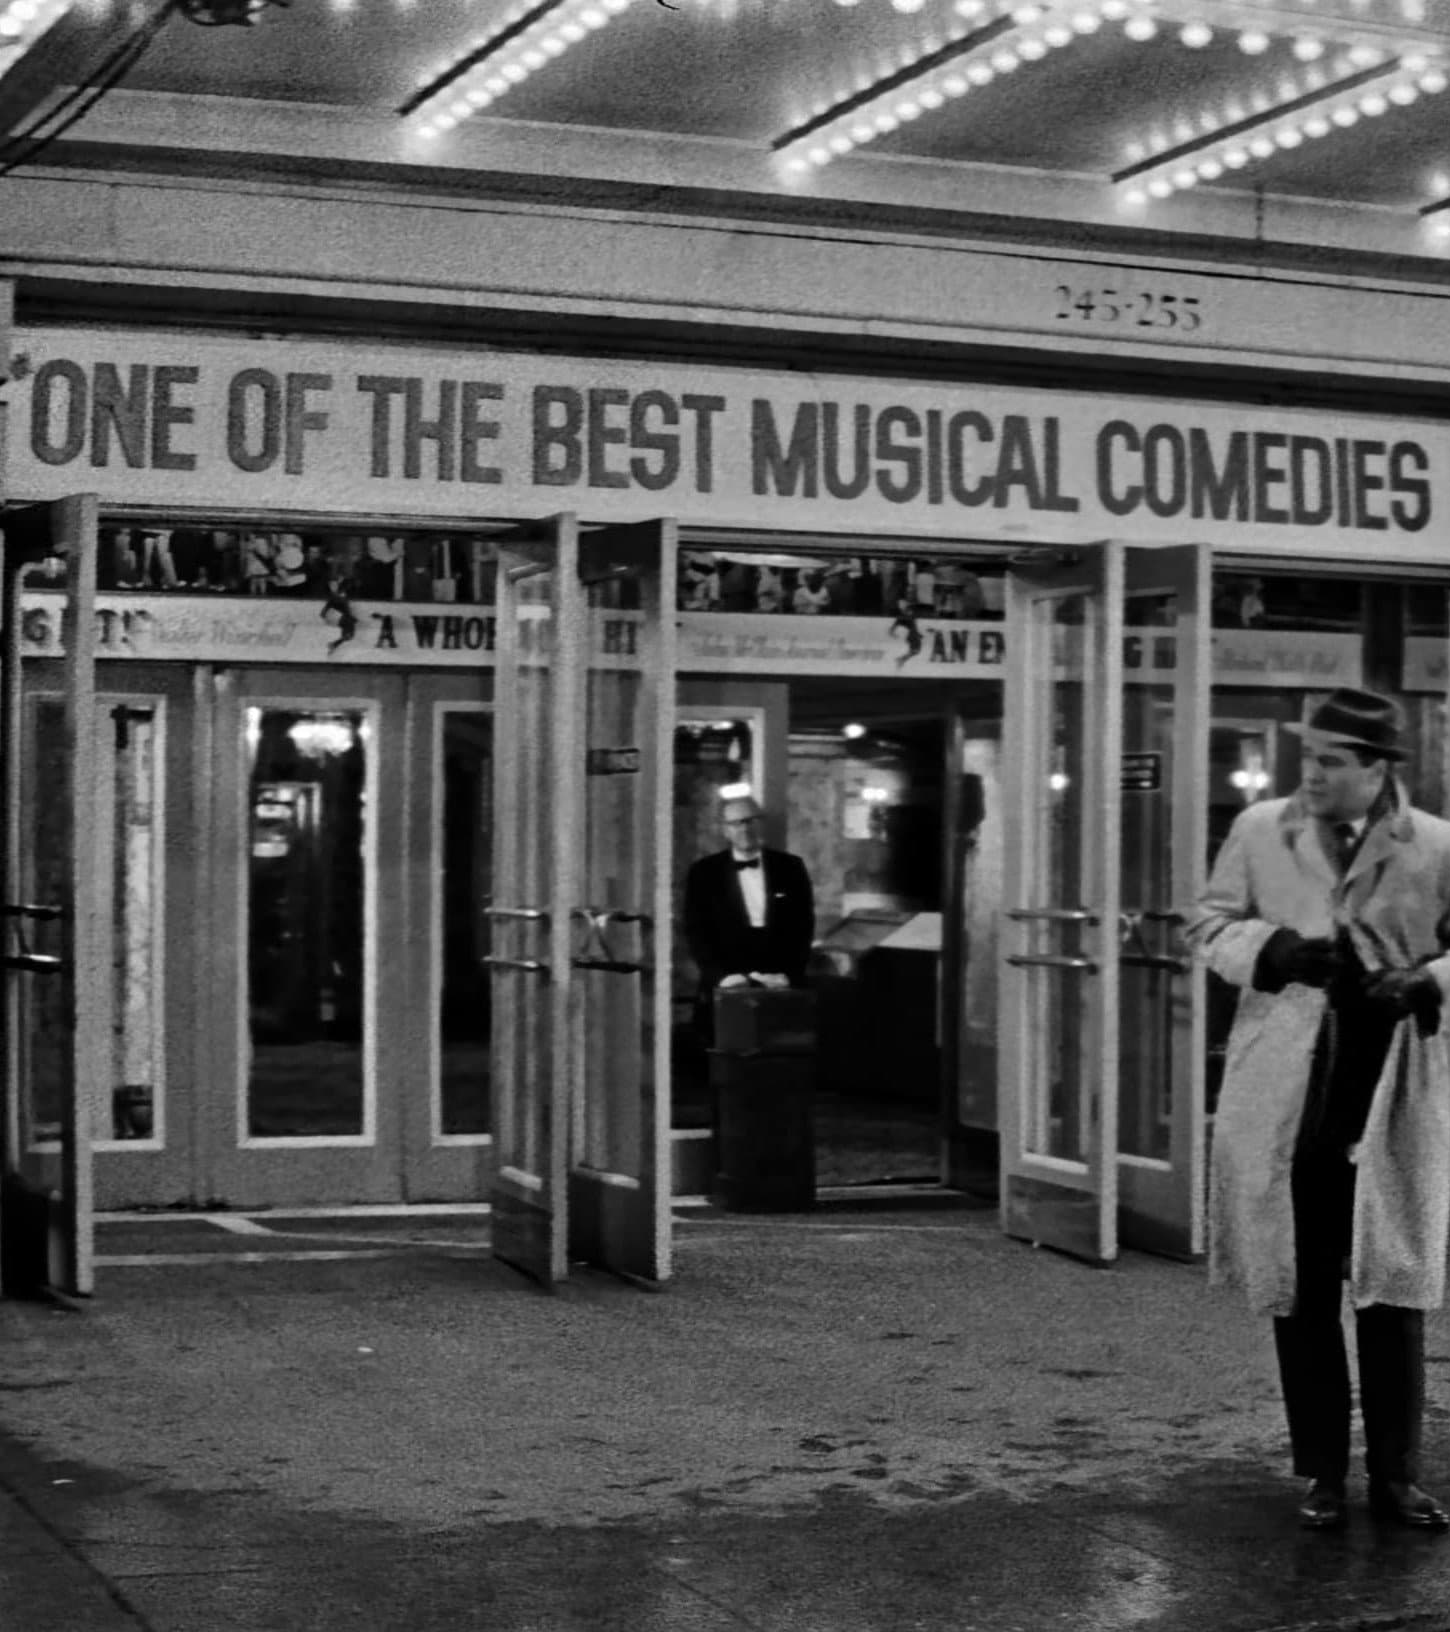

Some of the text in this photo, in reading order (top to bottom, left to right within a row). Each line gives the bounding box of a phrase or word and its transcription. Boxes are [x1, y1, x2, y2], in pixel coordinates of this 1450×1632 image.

[1055, 284, 1201, 332] 245-255
[226, 367, 333, 476] OF
[357, 375, 504, 484] THE
[531, 384, 727, 494] BEST
[751, 398, 1080, 513] MUSICAL
[1096, 419, 1432, 532] COMEDIES
